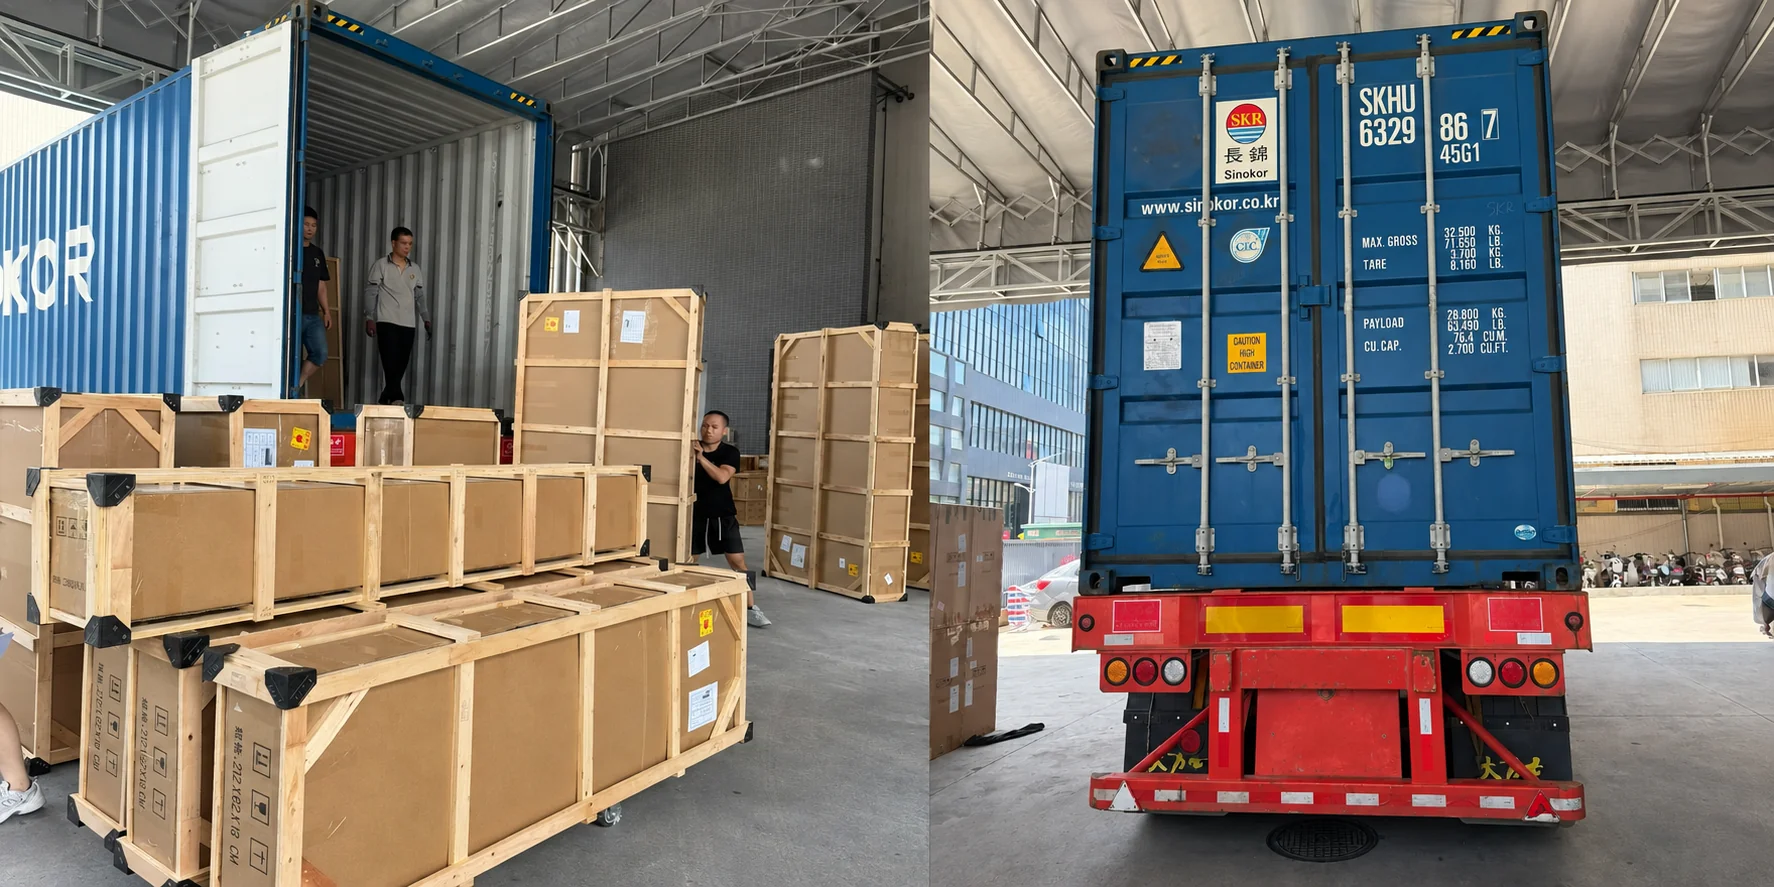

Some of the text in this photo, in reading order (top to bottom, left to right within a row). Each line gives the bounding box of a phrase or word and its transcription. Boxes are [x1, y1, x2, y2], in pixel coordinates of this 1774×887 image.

[1359, 84, 1416, 116] SKHU
[1231, 112, 1263, 127] SKR
[1359, 110, 1498, 147] 6329 86 7
[1439, 142, 1480, 164] 45G1
[1224, 169, 1269, 180] Sinokor
[1444, 225, 1503, 238] 32.500 KG.
[1362, 235, 1418, 248] MAX. GROSS
[1444, 236, 1503, 249] 71.650 LB.
[1489, 247, 1504, 257] KG.
[1363, 259, 1387, 270] TARE
[1450, 258, 1504, 270] 8.160 LB.
[0, 225, 95, 316] KOR
[1447, 307, 1507, 320] 28.800 KG.
[1363, 317, 1404, 329] PAYLOAD
[1447, 319, 1506, 331] 63.490 LB.
[1233, 336, 1261, 346] CAUTION
[1453, 331, 1474, 343] 76.4
[1239, 349, 1255, 357] HIGH
[1448, 343, 1475, 355] 2.700
[1229, 361, 1265, 371] CONTAINER
